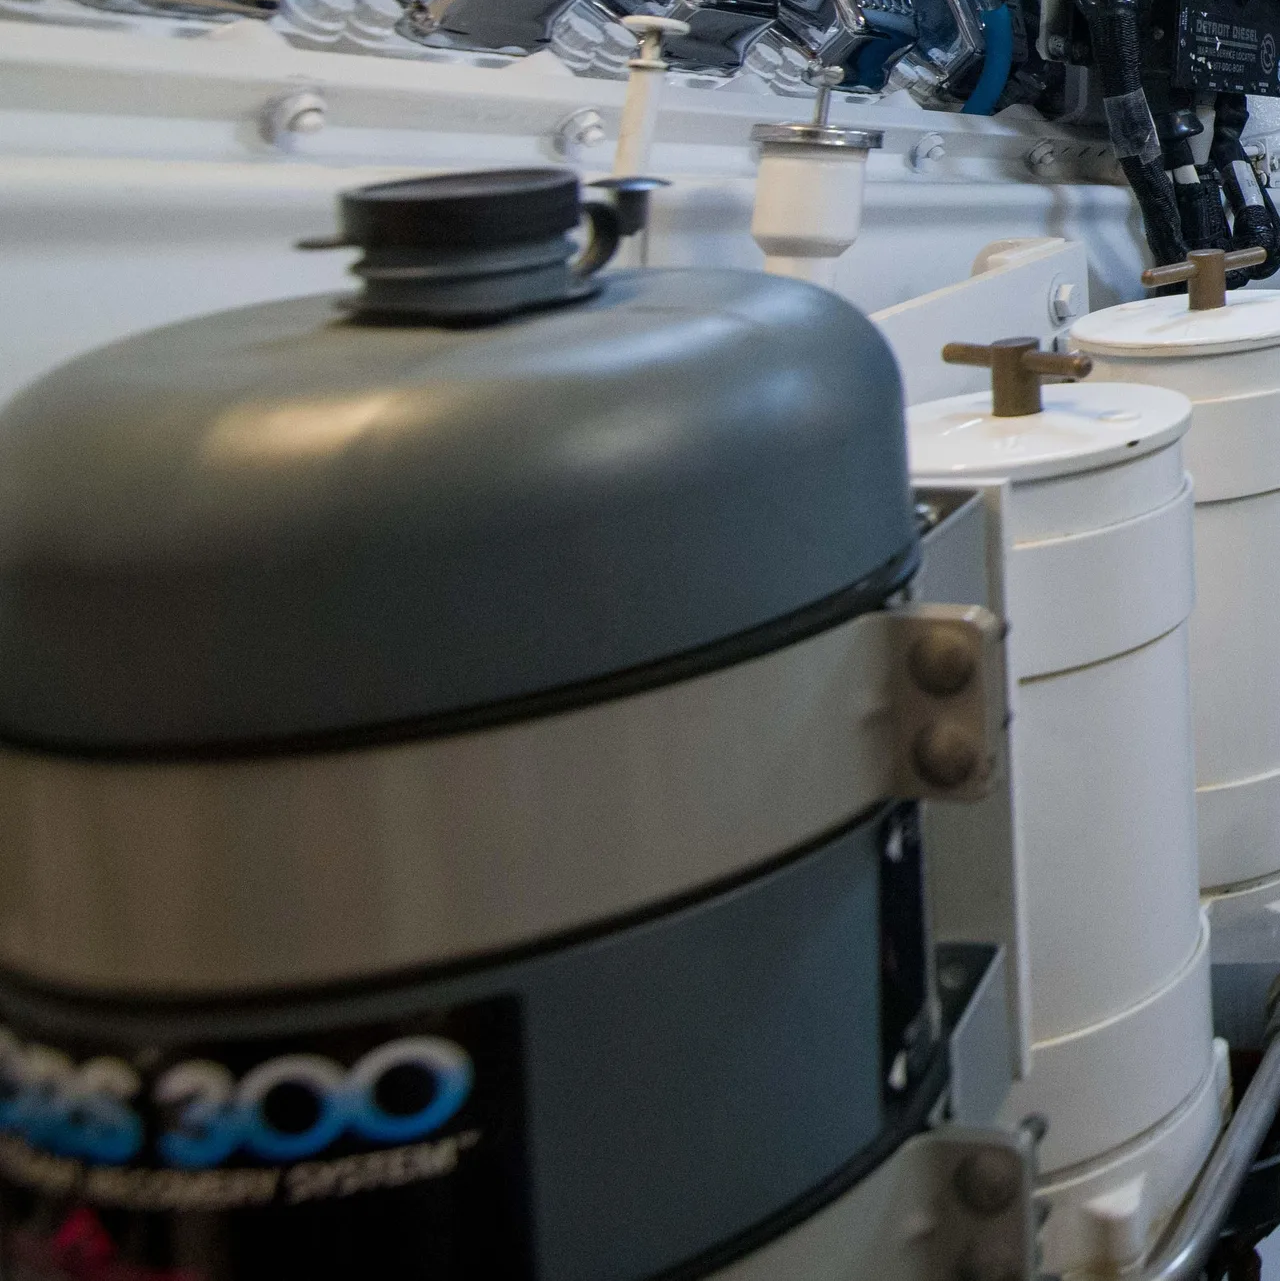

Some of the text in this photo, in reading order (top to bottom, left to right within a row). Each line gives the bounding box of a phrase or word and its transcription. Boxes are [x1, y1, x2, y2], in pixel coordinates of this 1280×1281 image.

[1196, 19, 1231, 38] DETROIT
[1232, 25, 1258, 43] DIESEL
[1217, 48, 1236, 60] SERVICE
[1236, 51, 1257, 63] LOCATOR
[153, 1034, 476, 1169] 300
